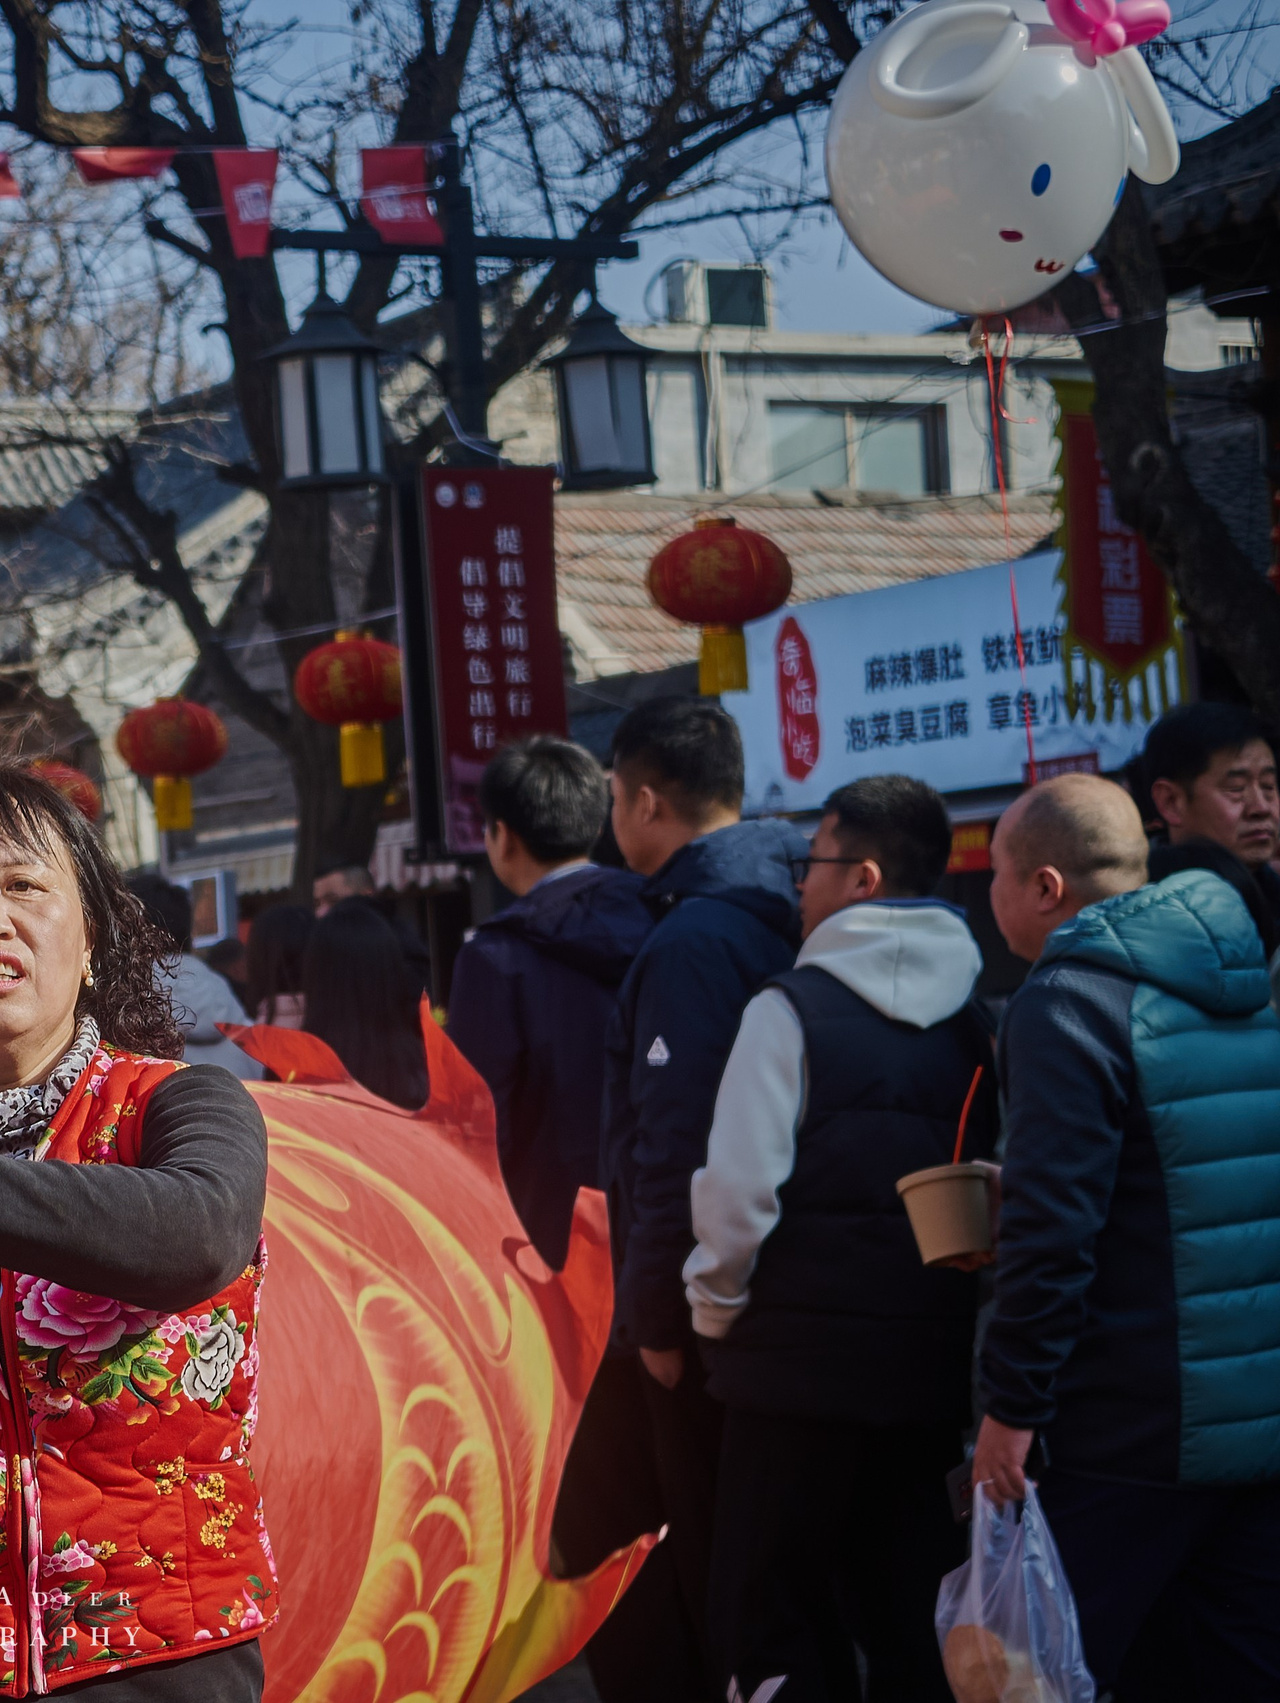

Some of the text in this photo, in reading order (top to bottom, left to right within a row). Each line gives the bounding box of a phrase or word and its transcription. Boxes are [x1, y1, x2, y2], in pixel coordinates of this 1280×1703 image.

[864, 640, 966, 694] 麻辣爆肚
[844, 699, 969, 754] 泡菜臭豆腐
